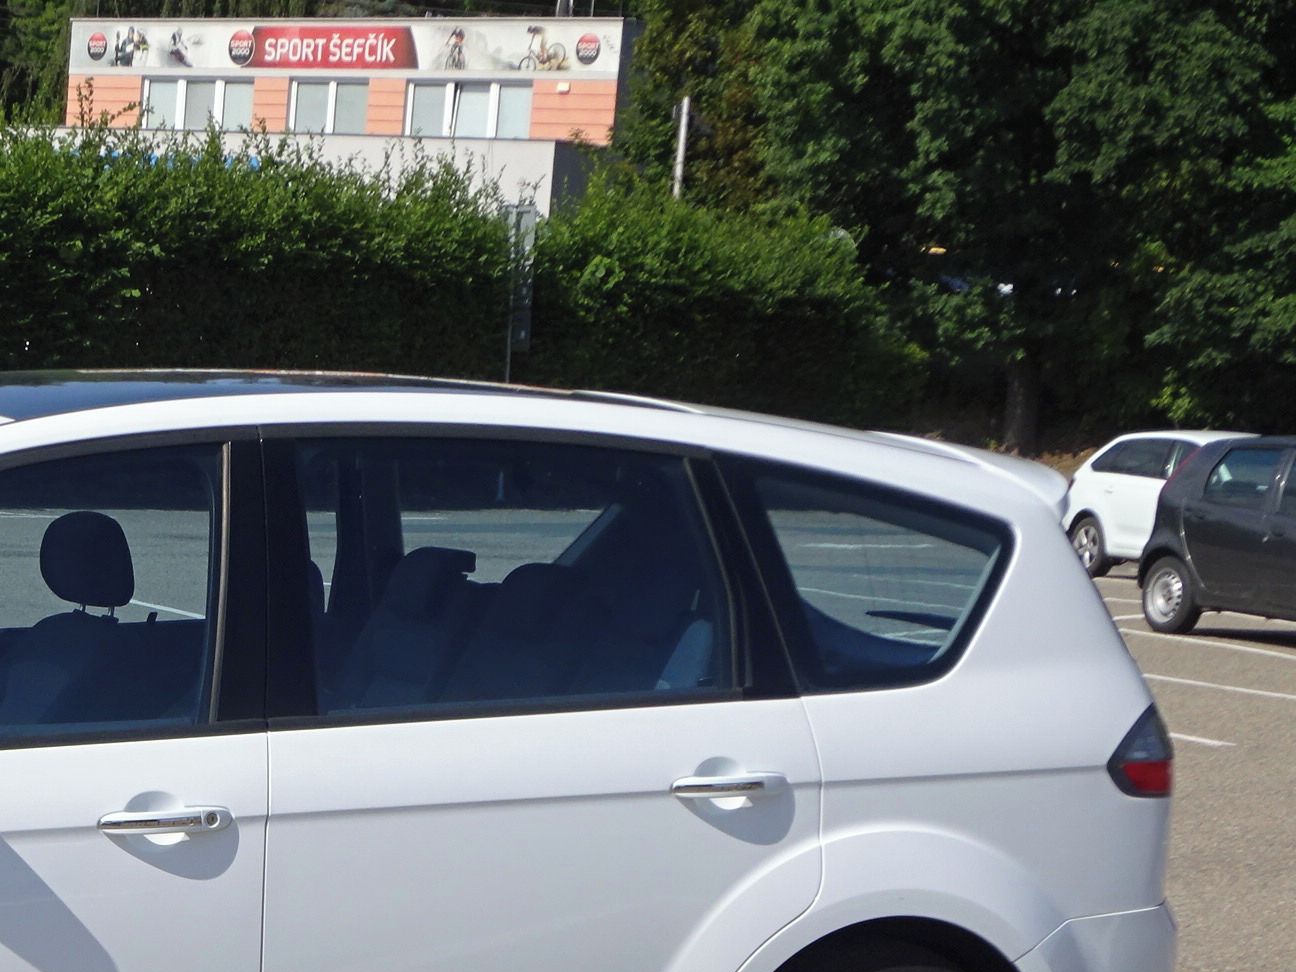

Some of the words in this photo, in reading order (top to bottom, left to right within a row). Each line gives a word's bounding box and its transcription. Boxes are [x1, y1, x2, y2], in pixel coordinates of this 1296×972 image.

[231, 40, 253, 48] SPORT
[264, 38, 326, 62] SPORT
[329, 33, 397, 62] ŠEFČÍK
[232, 48, 251, 56] 2000
